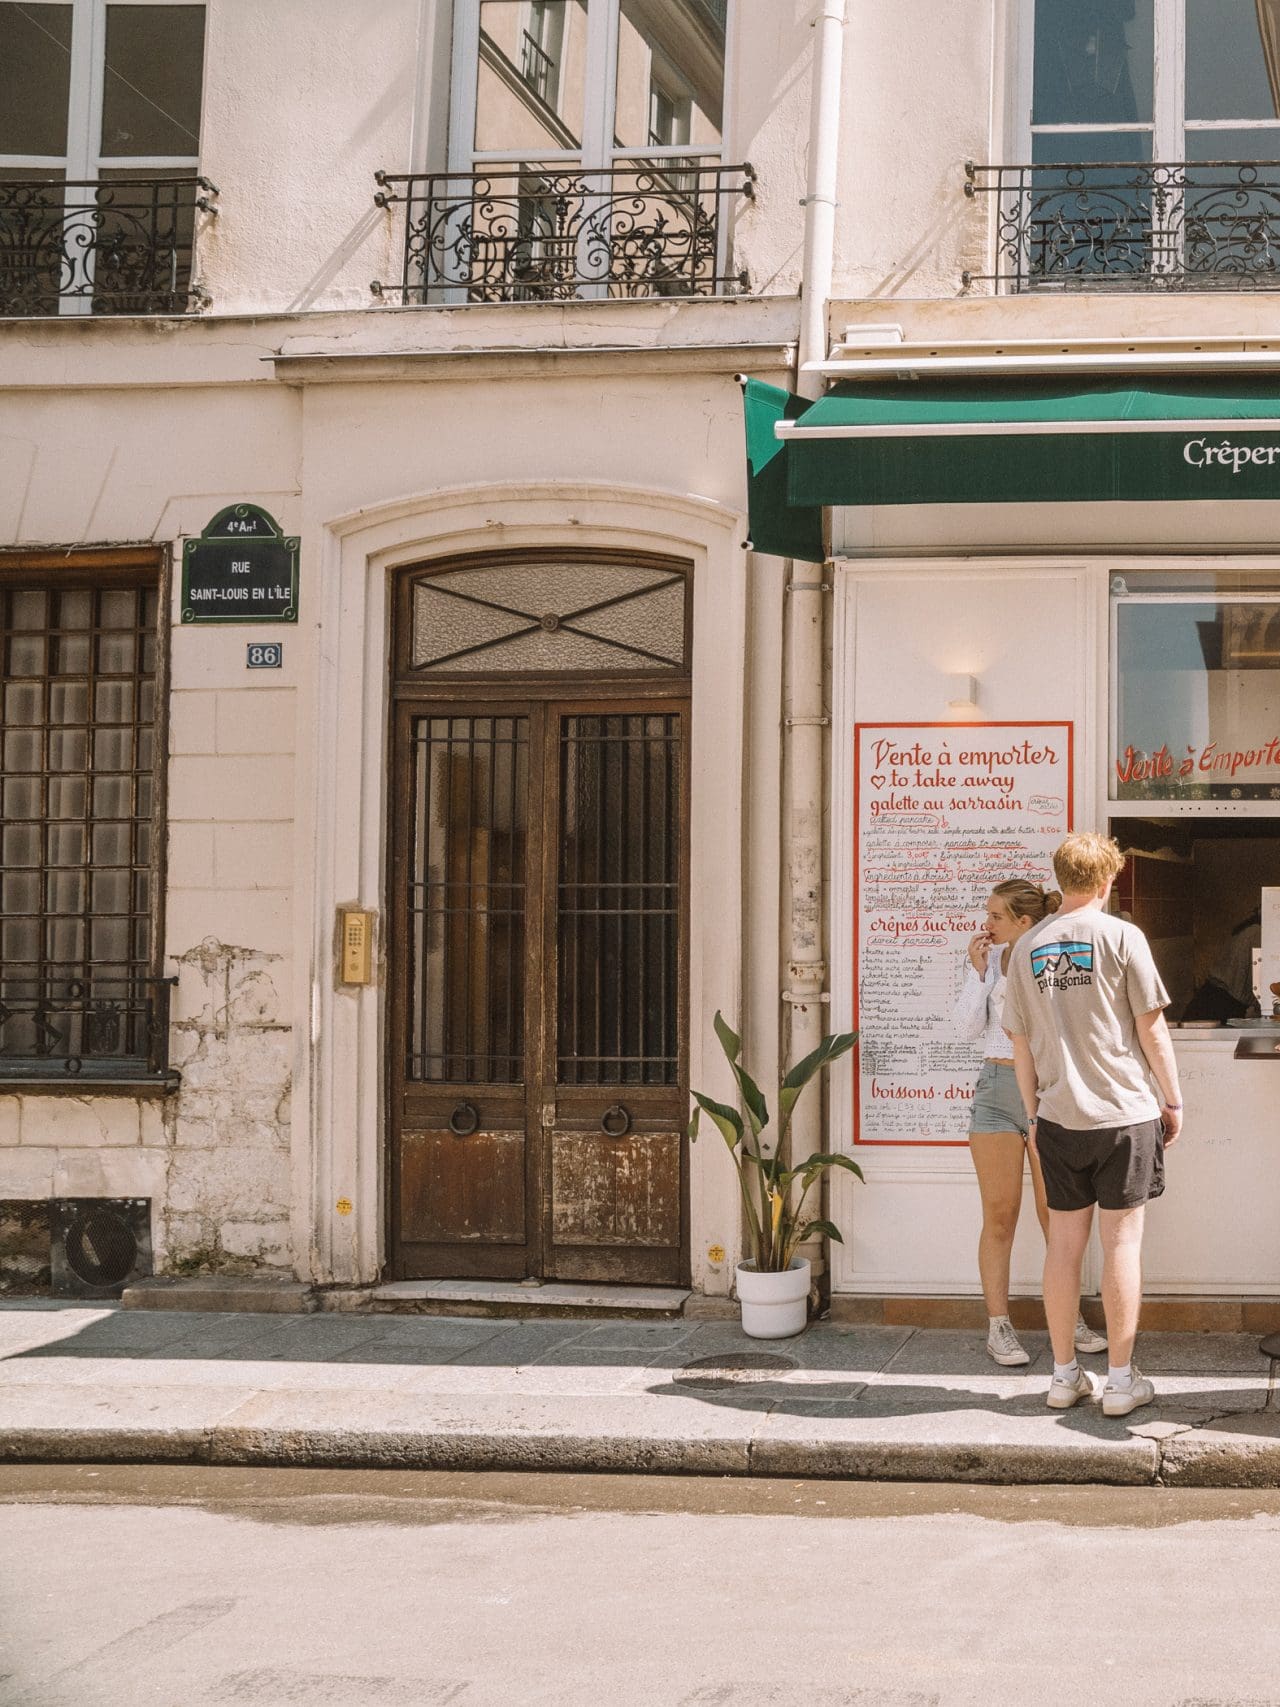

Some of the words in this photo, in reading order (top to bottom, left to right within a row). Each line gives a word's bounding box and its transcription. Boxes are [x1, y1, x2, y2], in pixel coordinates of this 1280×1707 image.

[231, 561, 251, 574] RUE
[190, 587, 249, 601] SAINT-LOUIS
[252, 587, 265, 600] EN
[251, 647, 276, 664] 86
[870, 738, 932, 770] Vente
[938, 742, 951, 766] à
[959, 740, 1060, 774] emporter
[1116, 744, 1173, 783] Vente
[888, 769, 909, 788] to
[912, 769, 956, 788] take
[960, 775, 1015, 794] away
[870, 792, 919, 816] galette
[923, 799, 944, 811] au
[949, 794, 1023, 811] sarrasin
[870, 916, 918, 937] crêpes
[1037, 974, 1092, 993] patagonia
[871, 1078, 935, 1099] boissons
